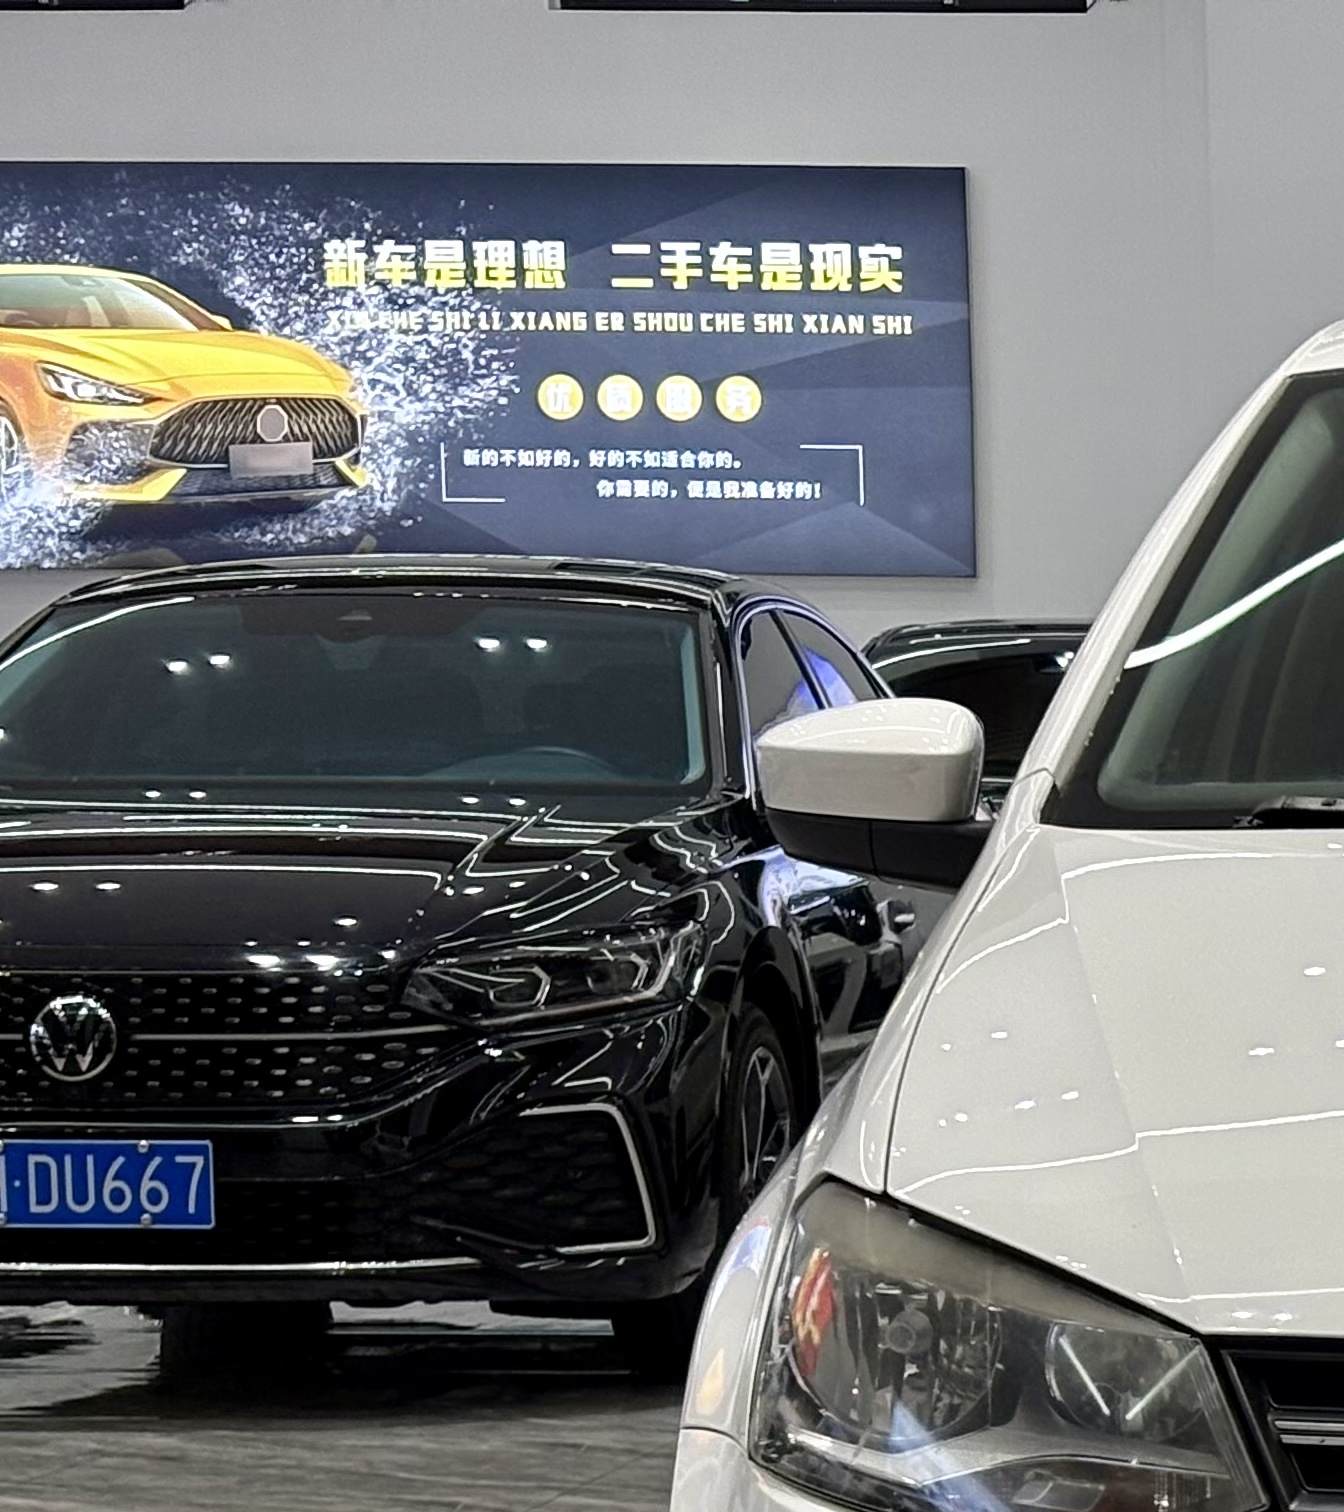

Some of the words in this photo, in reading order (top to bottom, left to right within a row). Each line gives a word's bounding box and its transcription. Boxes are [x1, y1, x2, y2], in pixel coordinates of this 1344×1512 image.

[323, 240, 567, 290] 新车是理想
[610, 241, 904, 293] 二手车是现实
[509, 311, 588, 332] XIANG
[595, 311, 625, 332] ER
[633, 312, 694, 332] SHOU
[700, 312, 746, 333] CHE
[754, 313, 795, 333] SHI
[802, 313, 864, 334] XIAN
[872, 314, 913, 335] SHI
